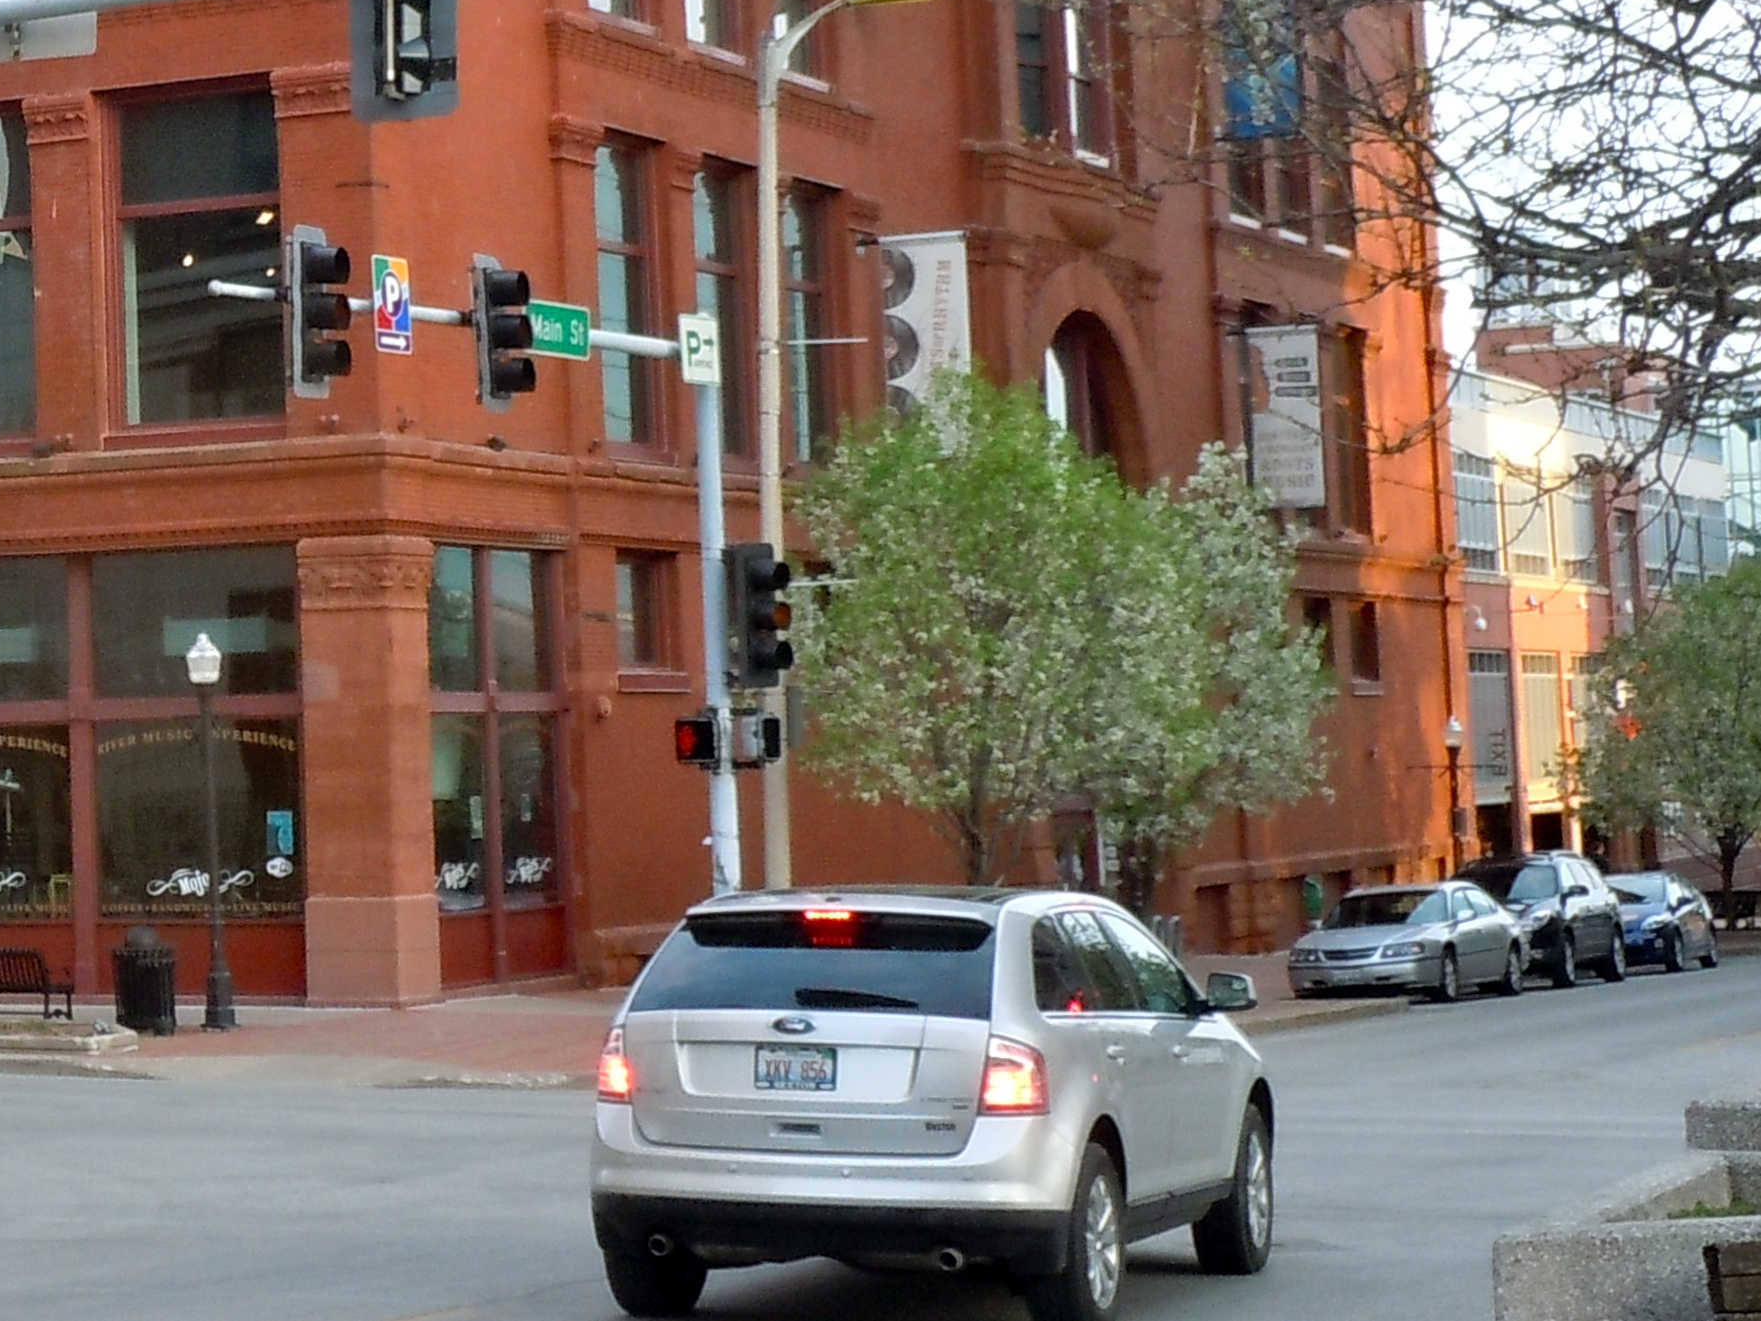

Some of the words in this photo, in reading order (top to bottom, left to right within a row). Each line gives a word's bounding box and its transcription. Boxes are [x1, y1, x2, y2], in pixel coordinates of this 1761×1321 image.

[384, 275, 400, 314] P
[530, 313, 563, 343] Main
[570, 319, 585, 347] St
[97, 735, 137, 756] RIVER
[141, 729, 193, 744] MUSIC
[210, 729, 298, 752] XPERIENCE
[177, 869, 210, 897] Mojo
[765, 1059, 792, 1080] XKV
[801, 1060, 828, 1081] 856
